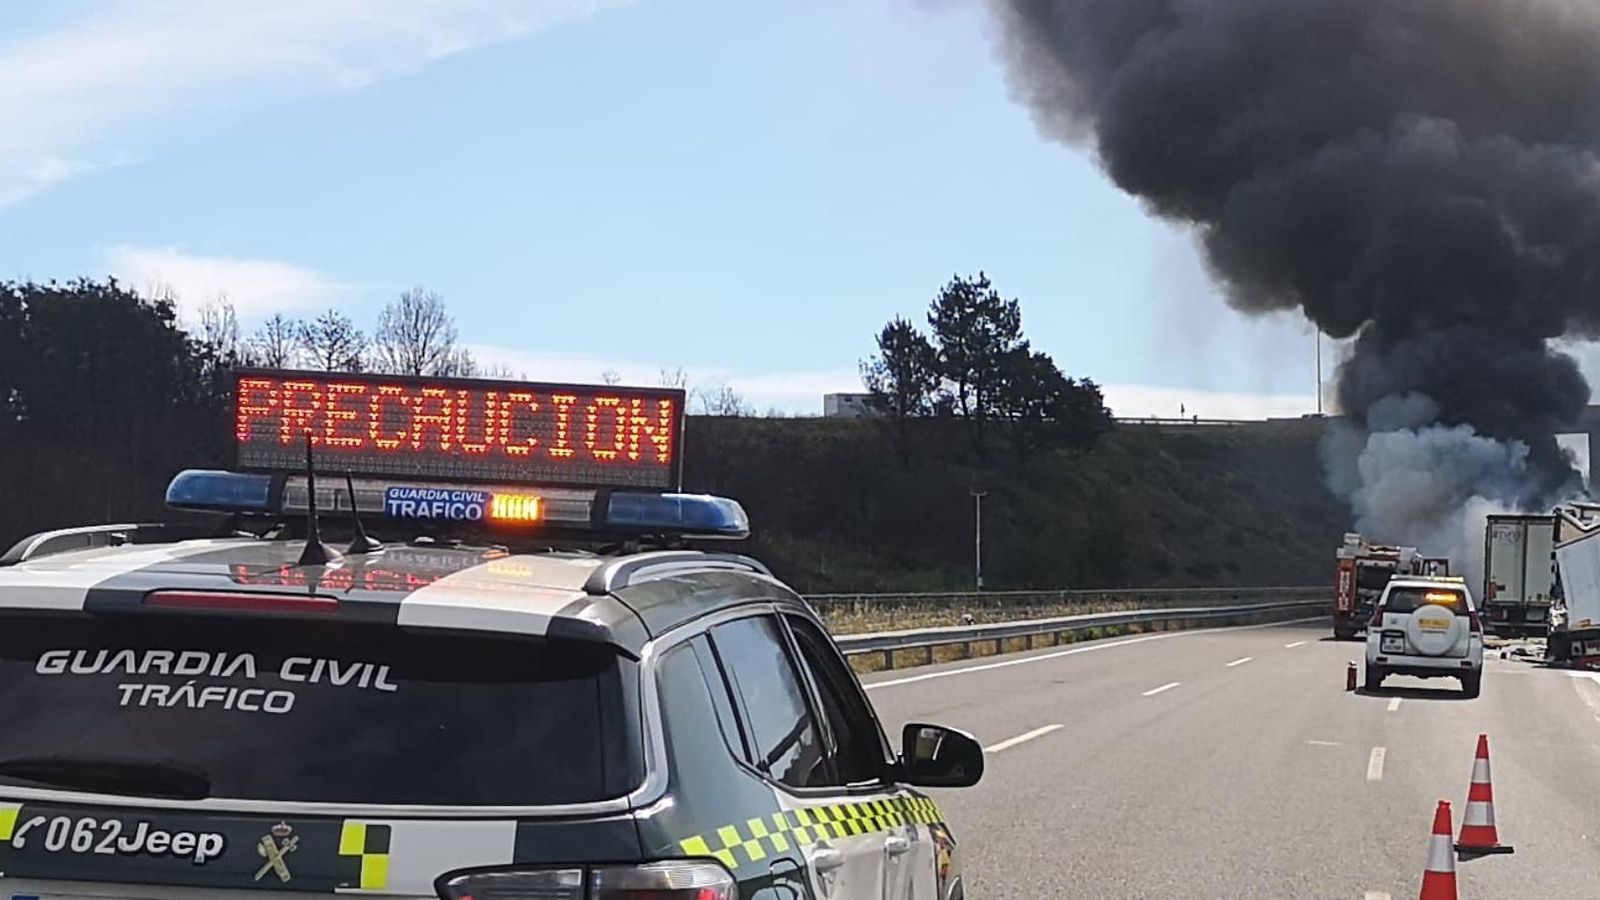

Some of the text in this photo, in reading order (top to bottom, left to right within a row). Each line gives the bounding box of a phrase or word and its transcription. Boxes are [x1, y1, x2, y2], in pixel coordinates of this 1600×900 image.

[236, 377, 674, 464] PRECAUCION
[387, 500, 483, 521] TRAFICO
[389, 488, 486, 503] GUARDIA CIVIL
[35, 649, 399, 692] GUARDIA CIVIL
[117, 680, 296, 714] TRÁFICO
[44, 815, 119, 855] 062
[117, 821, 224, 864] Jeep
